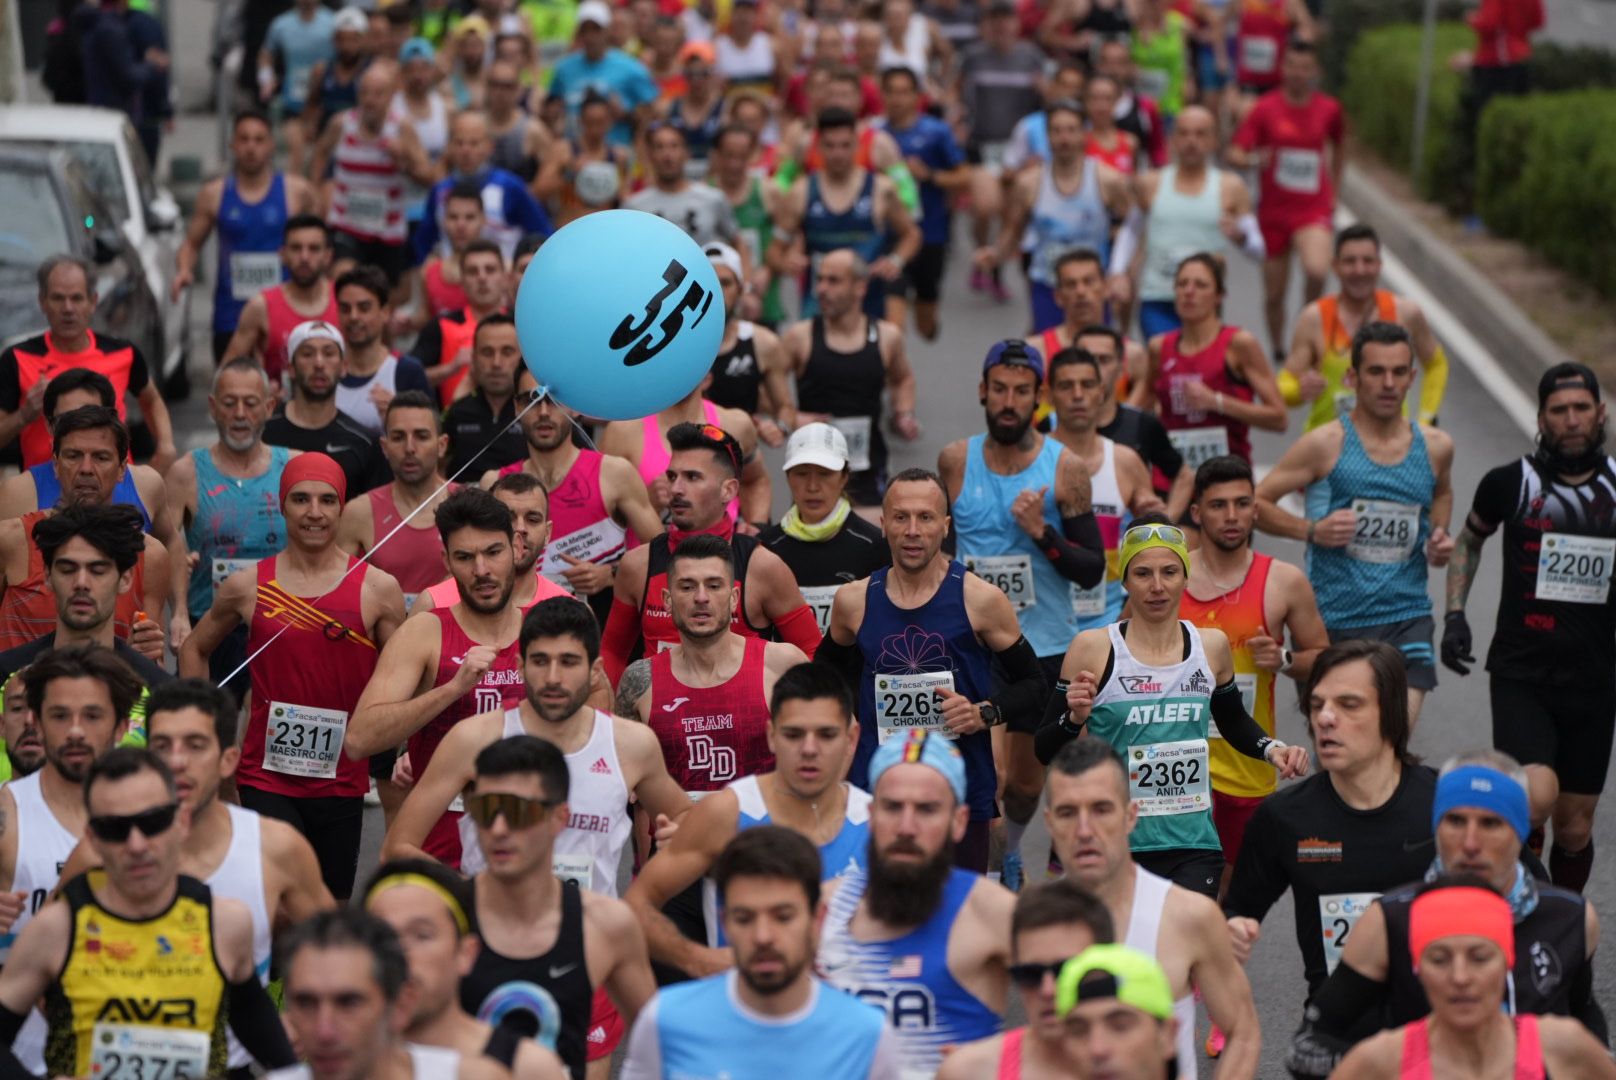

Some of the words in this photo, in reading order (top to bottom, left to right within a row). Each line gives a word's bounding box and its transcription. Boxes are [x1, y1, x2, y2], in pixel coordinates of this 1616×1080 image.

[1357, 517, 1409, 541] 2248
[1547, 551, 1604, 578] 2200
[478, 669, 523, 686] EAM
[884, 689, 944, 717] 2265
[1124, 703, 1204, 726] ATLEET
[681, 713, 733, 733] TEAM
[274, 722, 333, 752] 2311
[270, 744, 316, 760] MAESTRO
[686, 734, 737, 782] DD
[1138, 759, 1200, 788] 2362
[1156, 786, 1186, 797] ANITA
[102, 1051, 192, 1080] 2375
